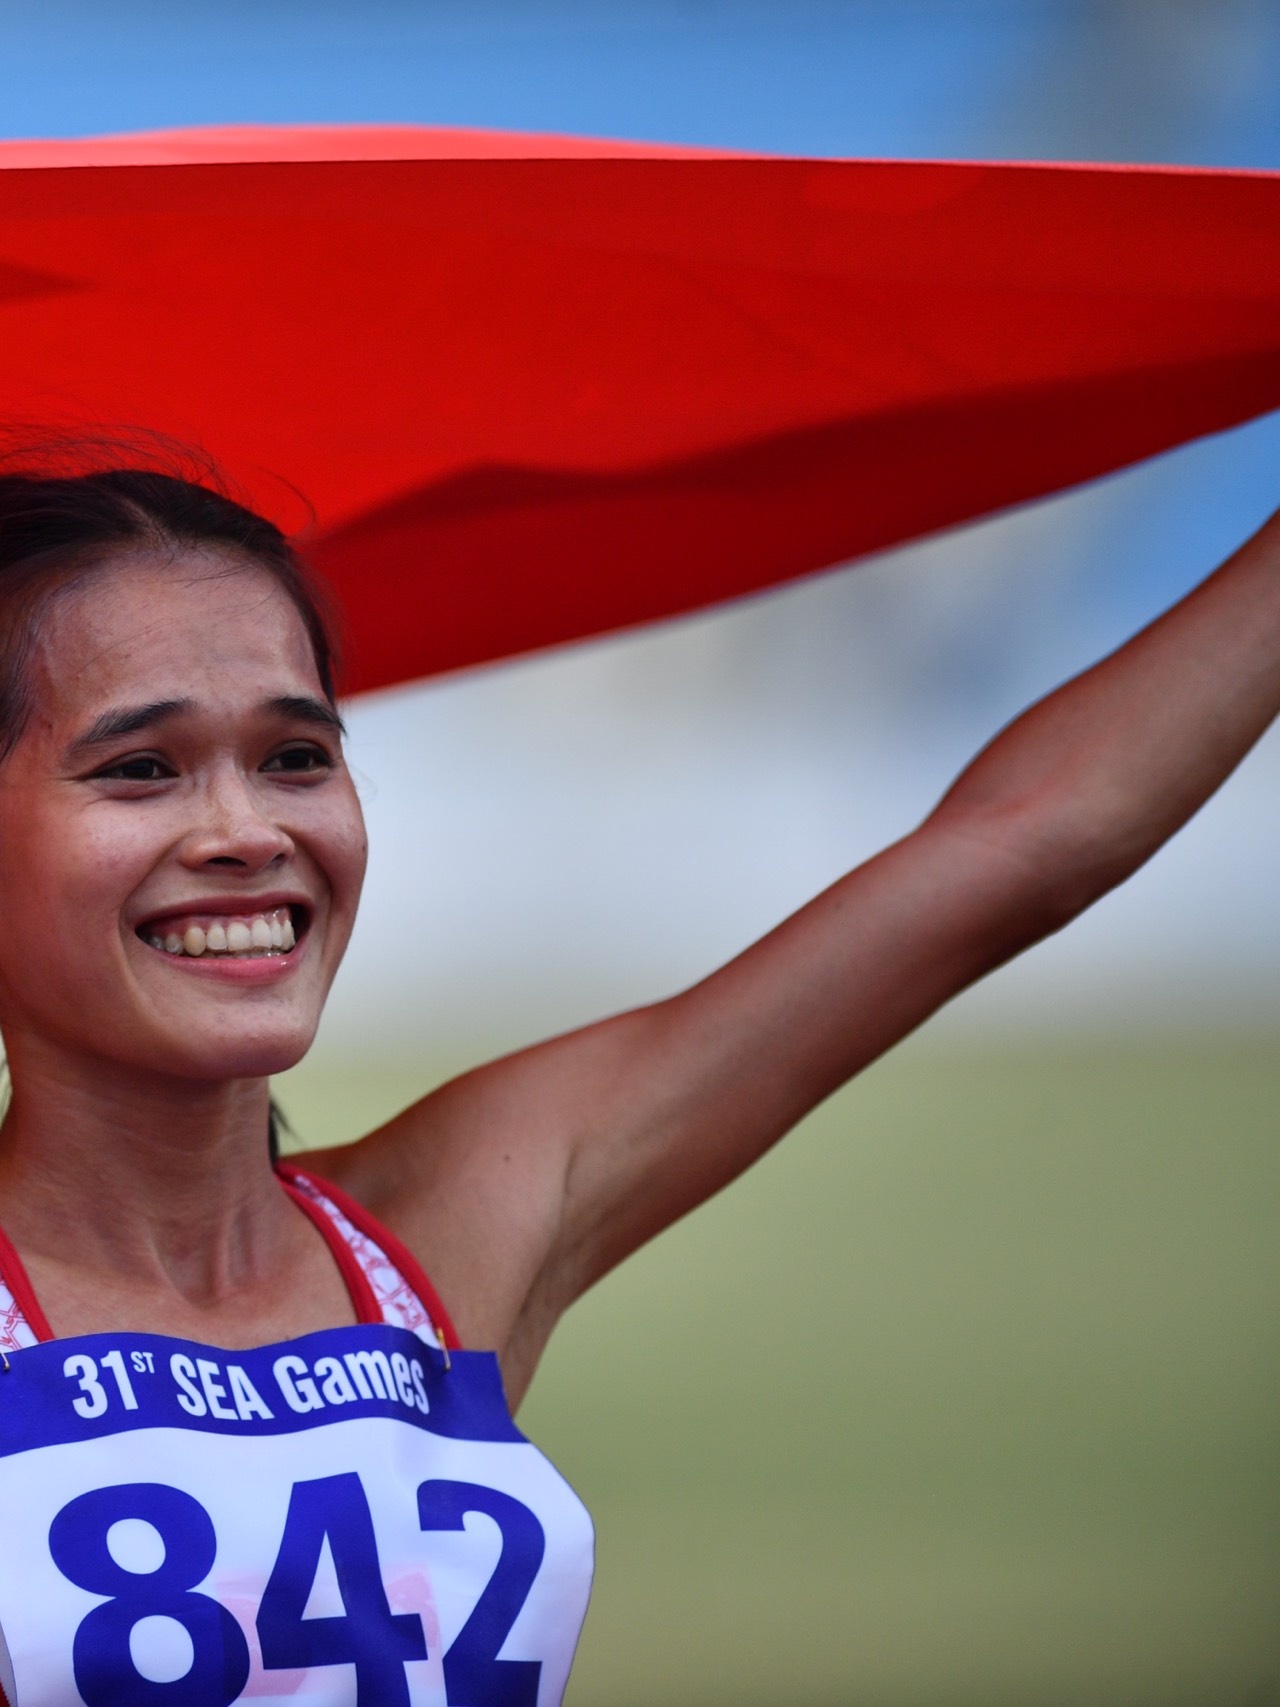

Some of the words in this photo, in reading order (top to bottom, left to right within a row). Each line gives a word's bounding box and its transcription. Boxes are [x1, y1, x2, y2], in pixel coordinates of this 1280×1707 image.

[169, 1353, 275, 1421] SEA
[272, 1350, 431, 1415] Games
[48, 1471, 546, 1707] 842
